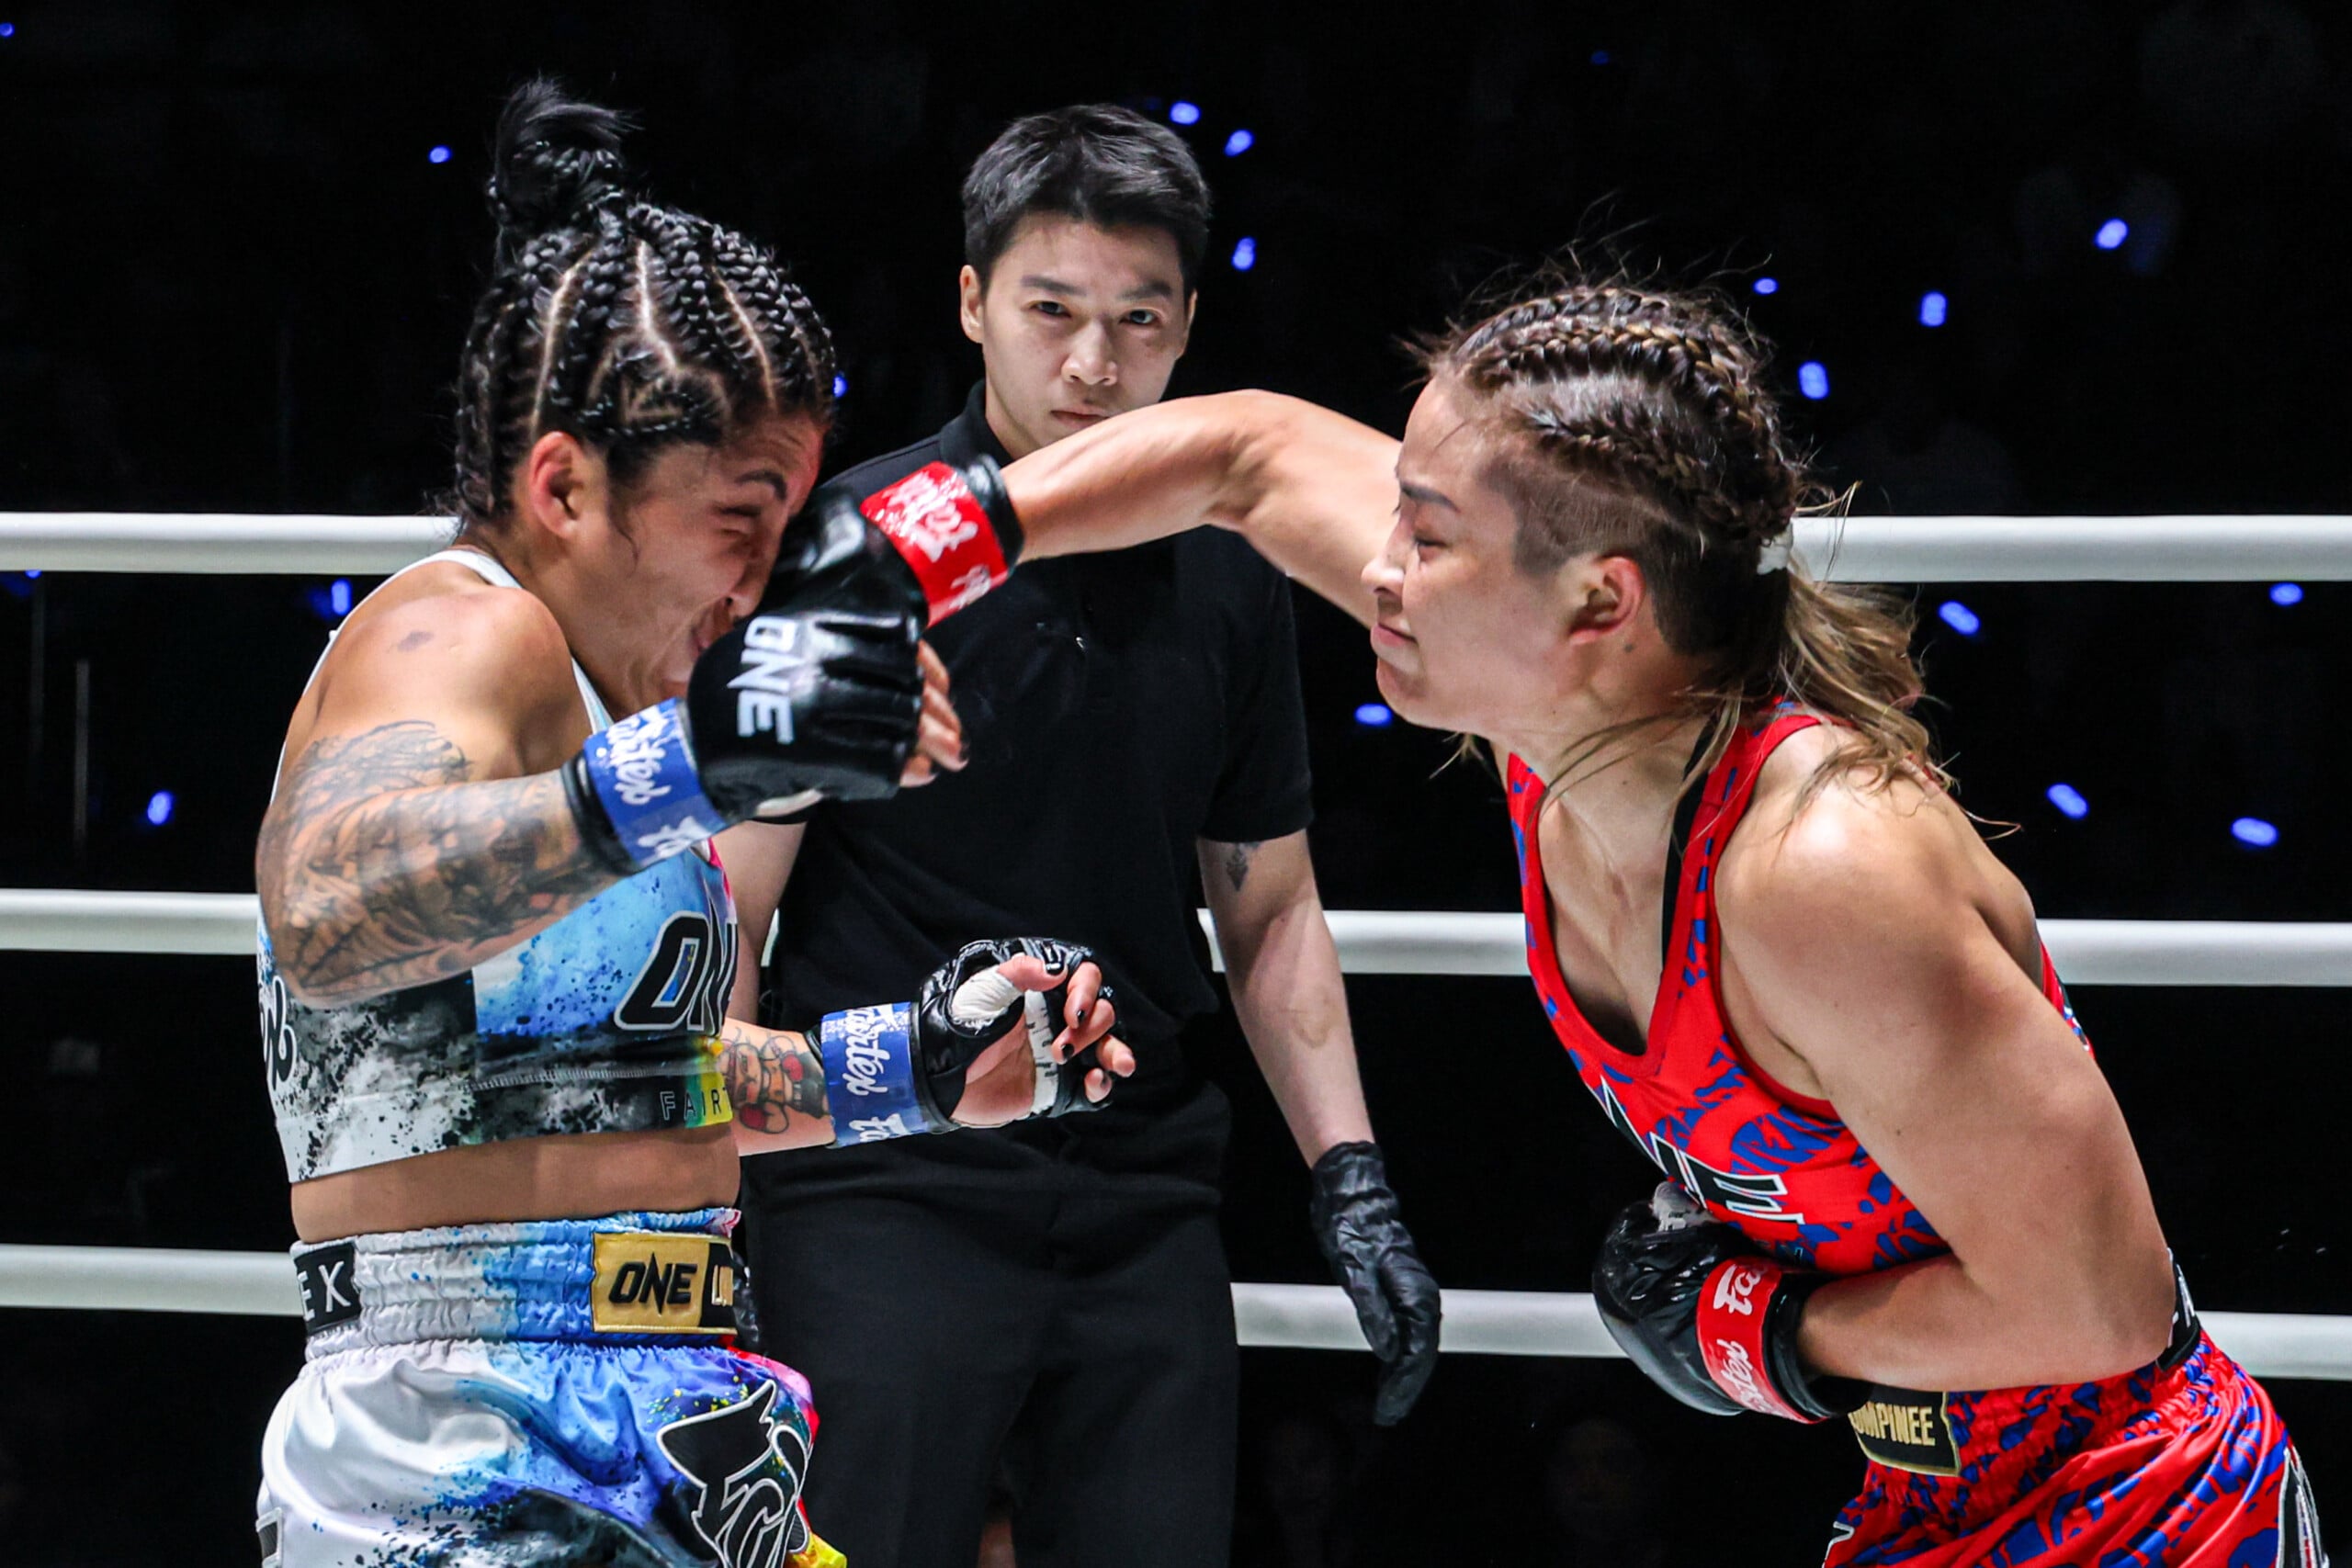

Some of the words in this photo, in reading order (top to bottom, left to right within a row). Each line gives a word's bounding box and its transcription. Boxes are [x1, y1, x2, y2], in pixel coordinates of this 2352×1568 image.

[726, 615, 801, 745] ONE
[614, 884, 739, 1036] ON
[660, 1088, 727, 1121] FAIR
[608, 1251, 698, 1315] ONE
